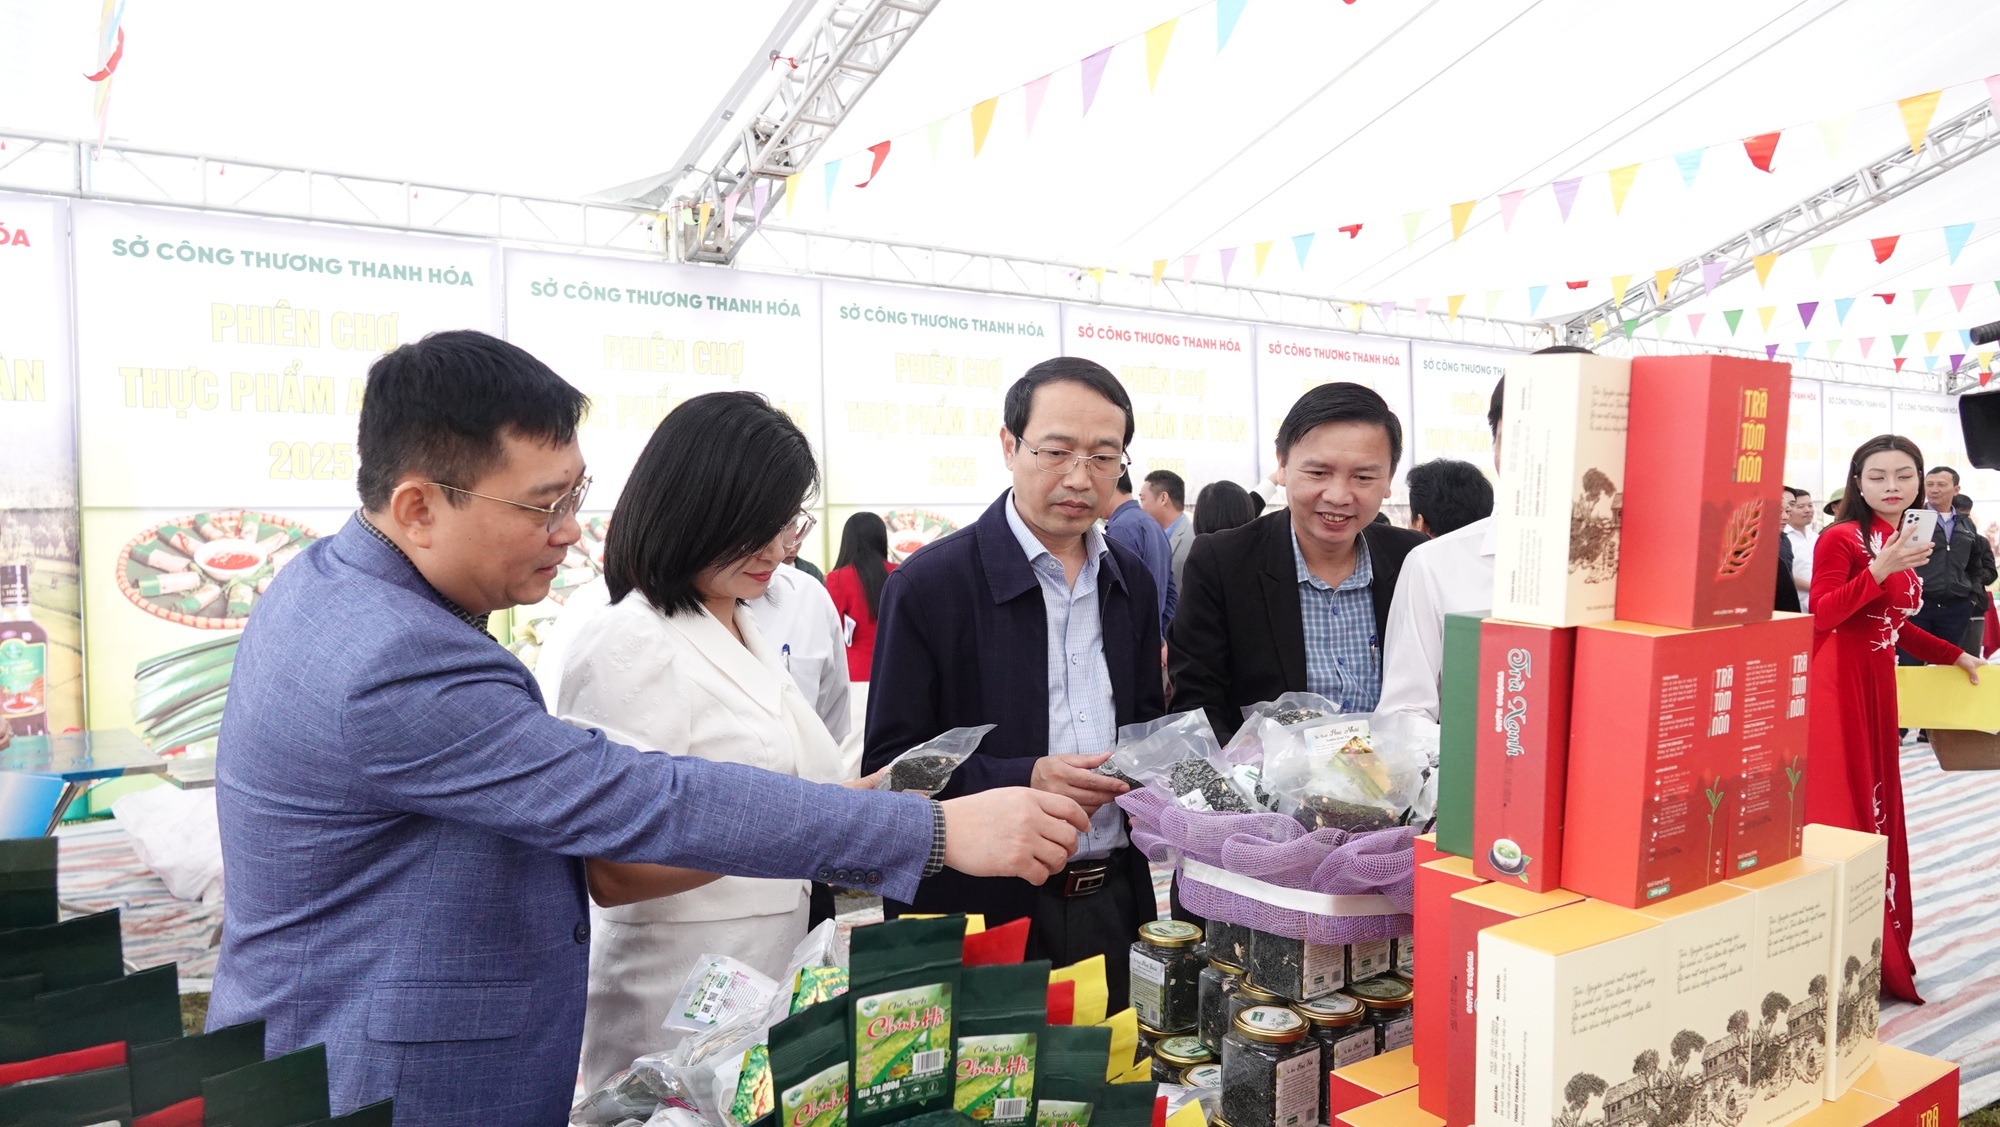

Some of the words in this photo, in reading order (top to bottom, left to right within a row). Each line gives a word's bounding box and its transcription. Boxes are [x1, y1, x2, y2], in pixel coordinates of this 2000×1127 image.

[112, 236, 149, 258] SỞ
[156, 241, 234, 265] CÔNG
[241, 250, 343, 275] THƯƠNG
[349, 260, 423, 282] THANH
[428, 264, 474, 287] HÓA
[531, 277, 559, 298] SỞ
[563, 281, 622, 303] CÔNG
[626, 288, 703, 310] THƯƠNG
[706, 295, 763, 315] THANH
[767, 298, 802, 317] HÓA
[211, 298, 320, 348] PHIÊN
[839, 303, 861, 321] SỞ
[864, 307, 907, 326] CÔNG
[911, 312, 968, 331] THƯƠNG
[971, 319, 1016, 335] THANH
[1017, 321, 1045, 338] HÓA
[1077, 323, 1094, 339] SỞ
[1096, 325, 1132, 343] CÔNG
[1134, 330, 1180, 348] THƯƠNG
[1182, 335, 1217, 350] THANH
[1219, 336, 1242, 352] HÓA
[603, 331, 685, 373] PHIÊN
[692, 340, 745, 383] CHỢ
[895, 348, 957, 387] PHIÊN
[1268, 340, 1282, 354] SỞ
[1284, 342, 1312, 357] CÔNG
[1314, 347, 1350, 361] THƯƠNG
[1352, 351, 1381, 365] THANH
[1382, 352, 1401, 367] HÓA
[1423, 358, 1435, 370] SỞ
[1436, 359, 1459, 372] CÔNG
[1461, 363, 1491, 375] THƯƠNG
[1493, 366, 1506, 377] THA
[118, 366, 219, 419] THỰC
[229, 359, 336, 414] PHẨM
[1120, 362, 1171, 395] PHIÊN
[1744, 387, 1769, 418] TRÀ
[1741, 420, 1766, 451] TÔM
[269, 441, 354, 481] 2025
[1507, 648, 1532, 692] Trà
[1716, 665, 1734, 689] TRÀ
[1793, 651, 1808, 674] TRÀ
[1714, 689, 1732, 713] TÔM
[1791, 675, 1807, 696] TÔM
[1503, 696, 1527, 757] Xanh
[867, 1010, 920, 1041] Chính
[921, 1004, 946, 1030] Hà
[955, 1057, 1004, 1080] Chính
[1005, 1054, 1030, 1078] Hà
